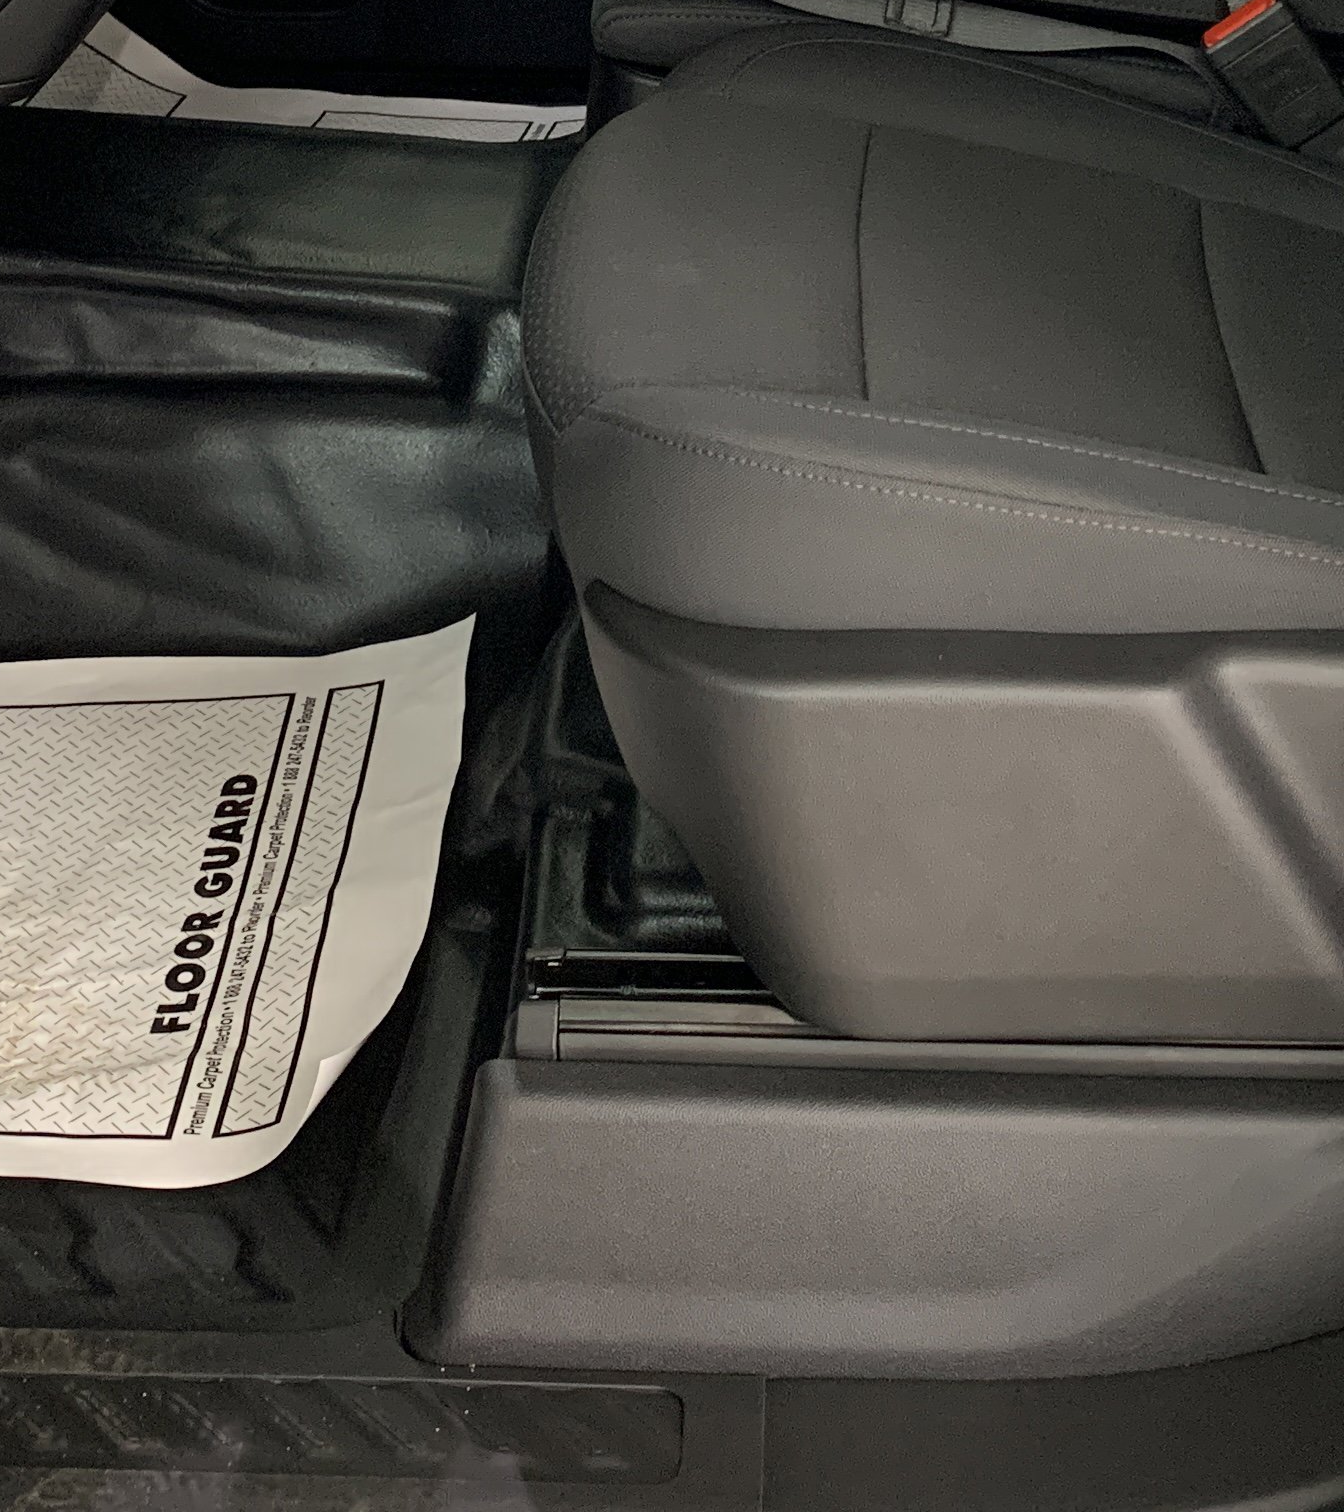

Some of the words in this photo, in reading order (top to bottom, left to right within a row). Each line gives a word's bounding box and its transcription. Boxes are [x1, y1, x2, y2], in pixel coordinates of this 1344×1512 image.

[263, 832, 285, 859] Carpet
[150, 909, 225, 1034] FLOOR
[194, 774, 258, 899] GUARD
[240, 933, 256, 944] to
[212, 1011, 234, 1055] Protection
[197, 1051, 223, 1089] Carpet
[183, 1092, 212, 1135] Premium
